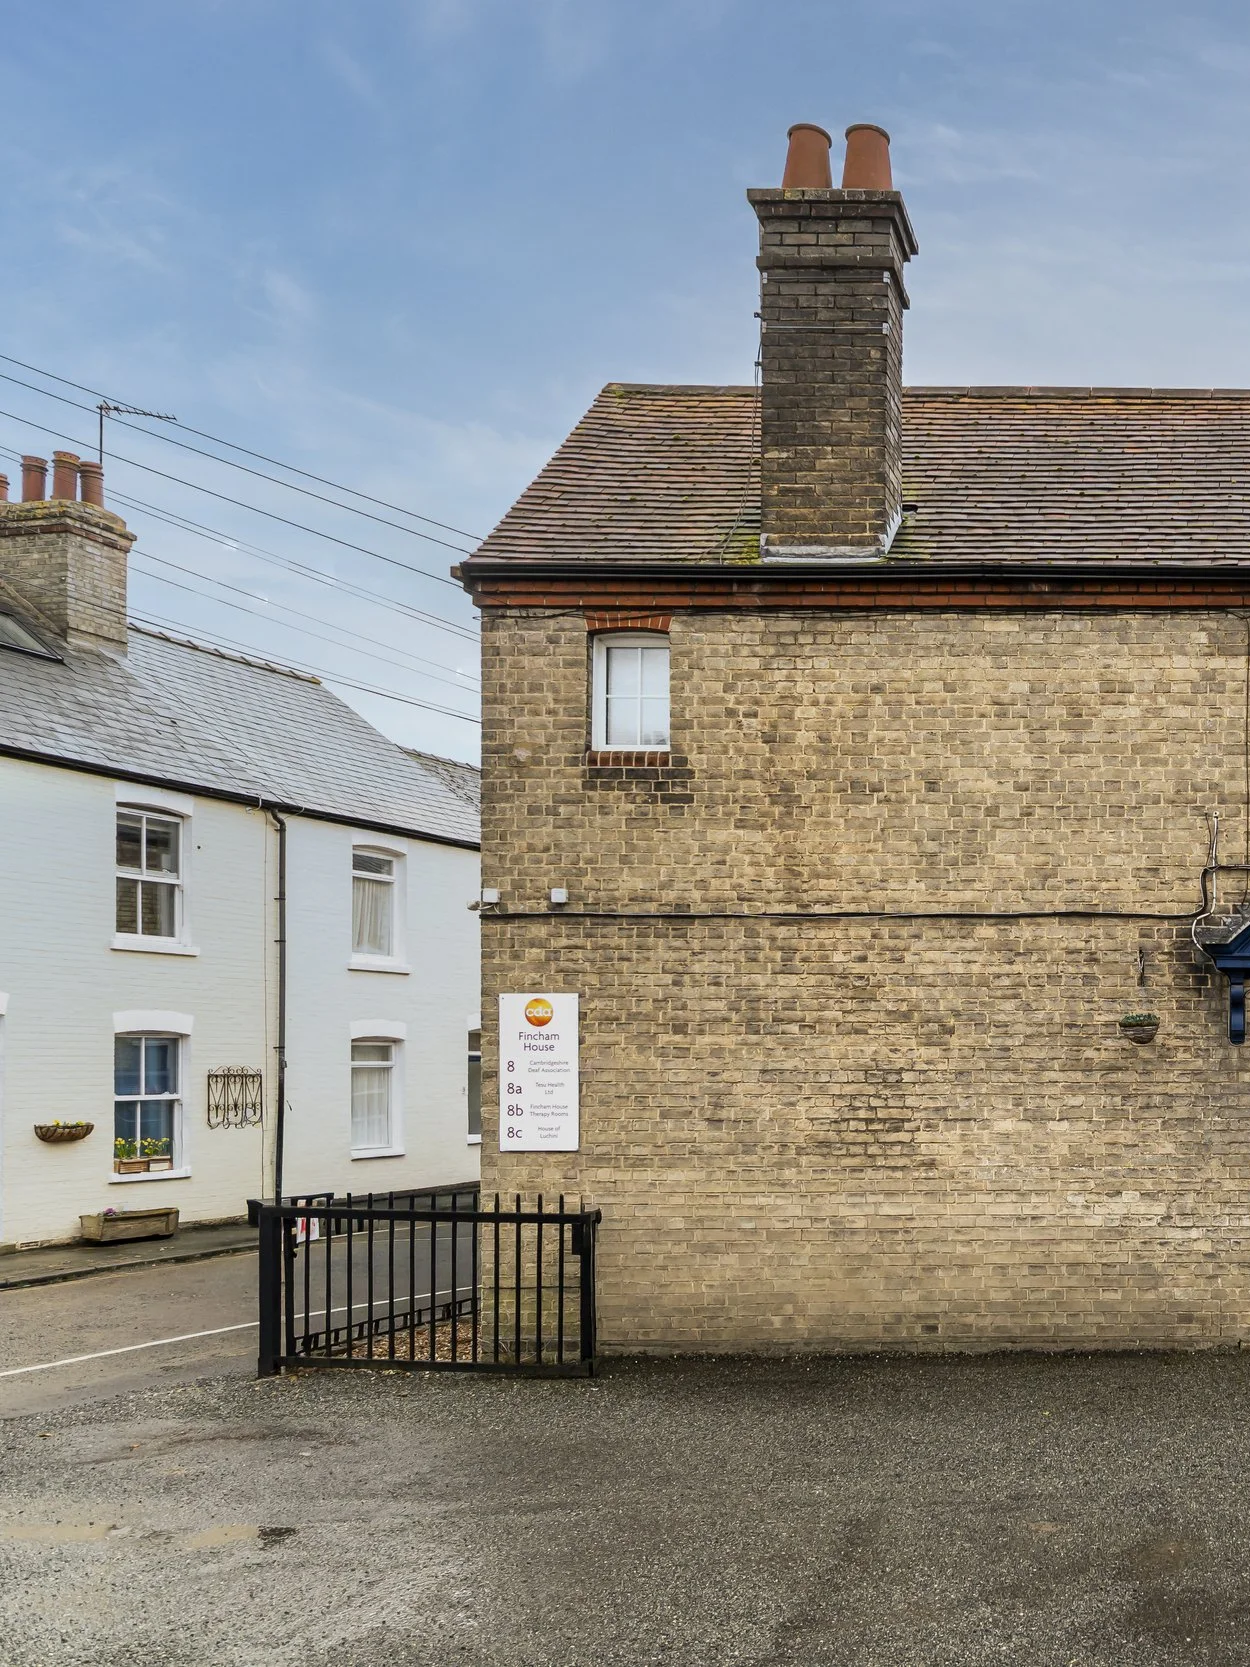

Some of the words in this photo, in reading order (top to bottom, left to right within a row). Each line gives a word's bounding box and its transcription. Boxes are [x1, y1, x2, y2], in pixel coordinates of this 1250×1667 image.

[526, 1006, 553, 1017] cda
[518, 1031, 560, 1041] Fincham
[523, 1042, 555, 1052] House
[507, 1060, 515, 1073] 8
[507, 1082, 523, 1095] 8a
[507, 1103, 524, 1117] 8b
[507, 1126, 523, 1139] 8c
